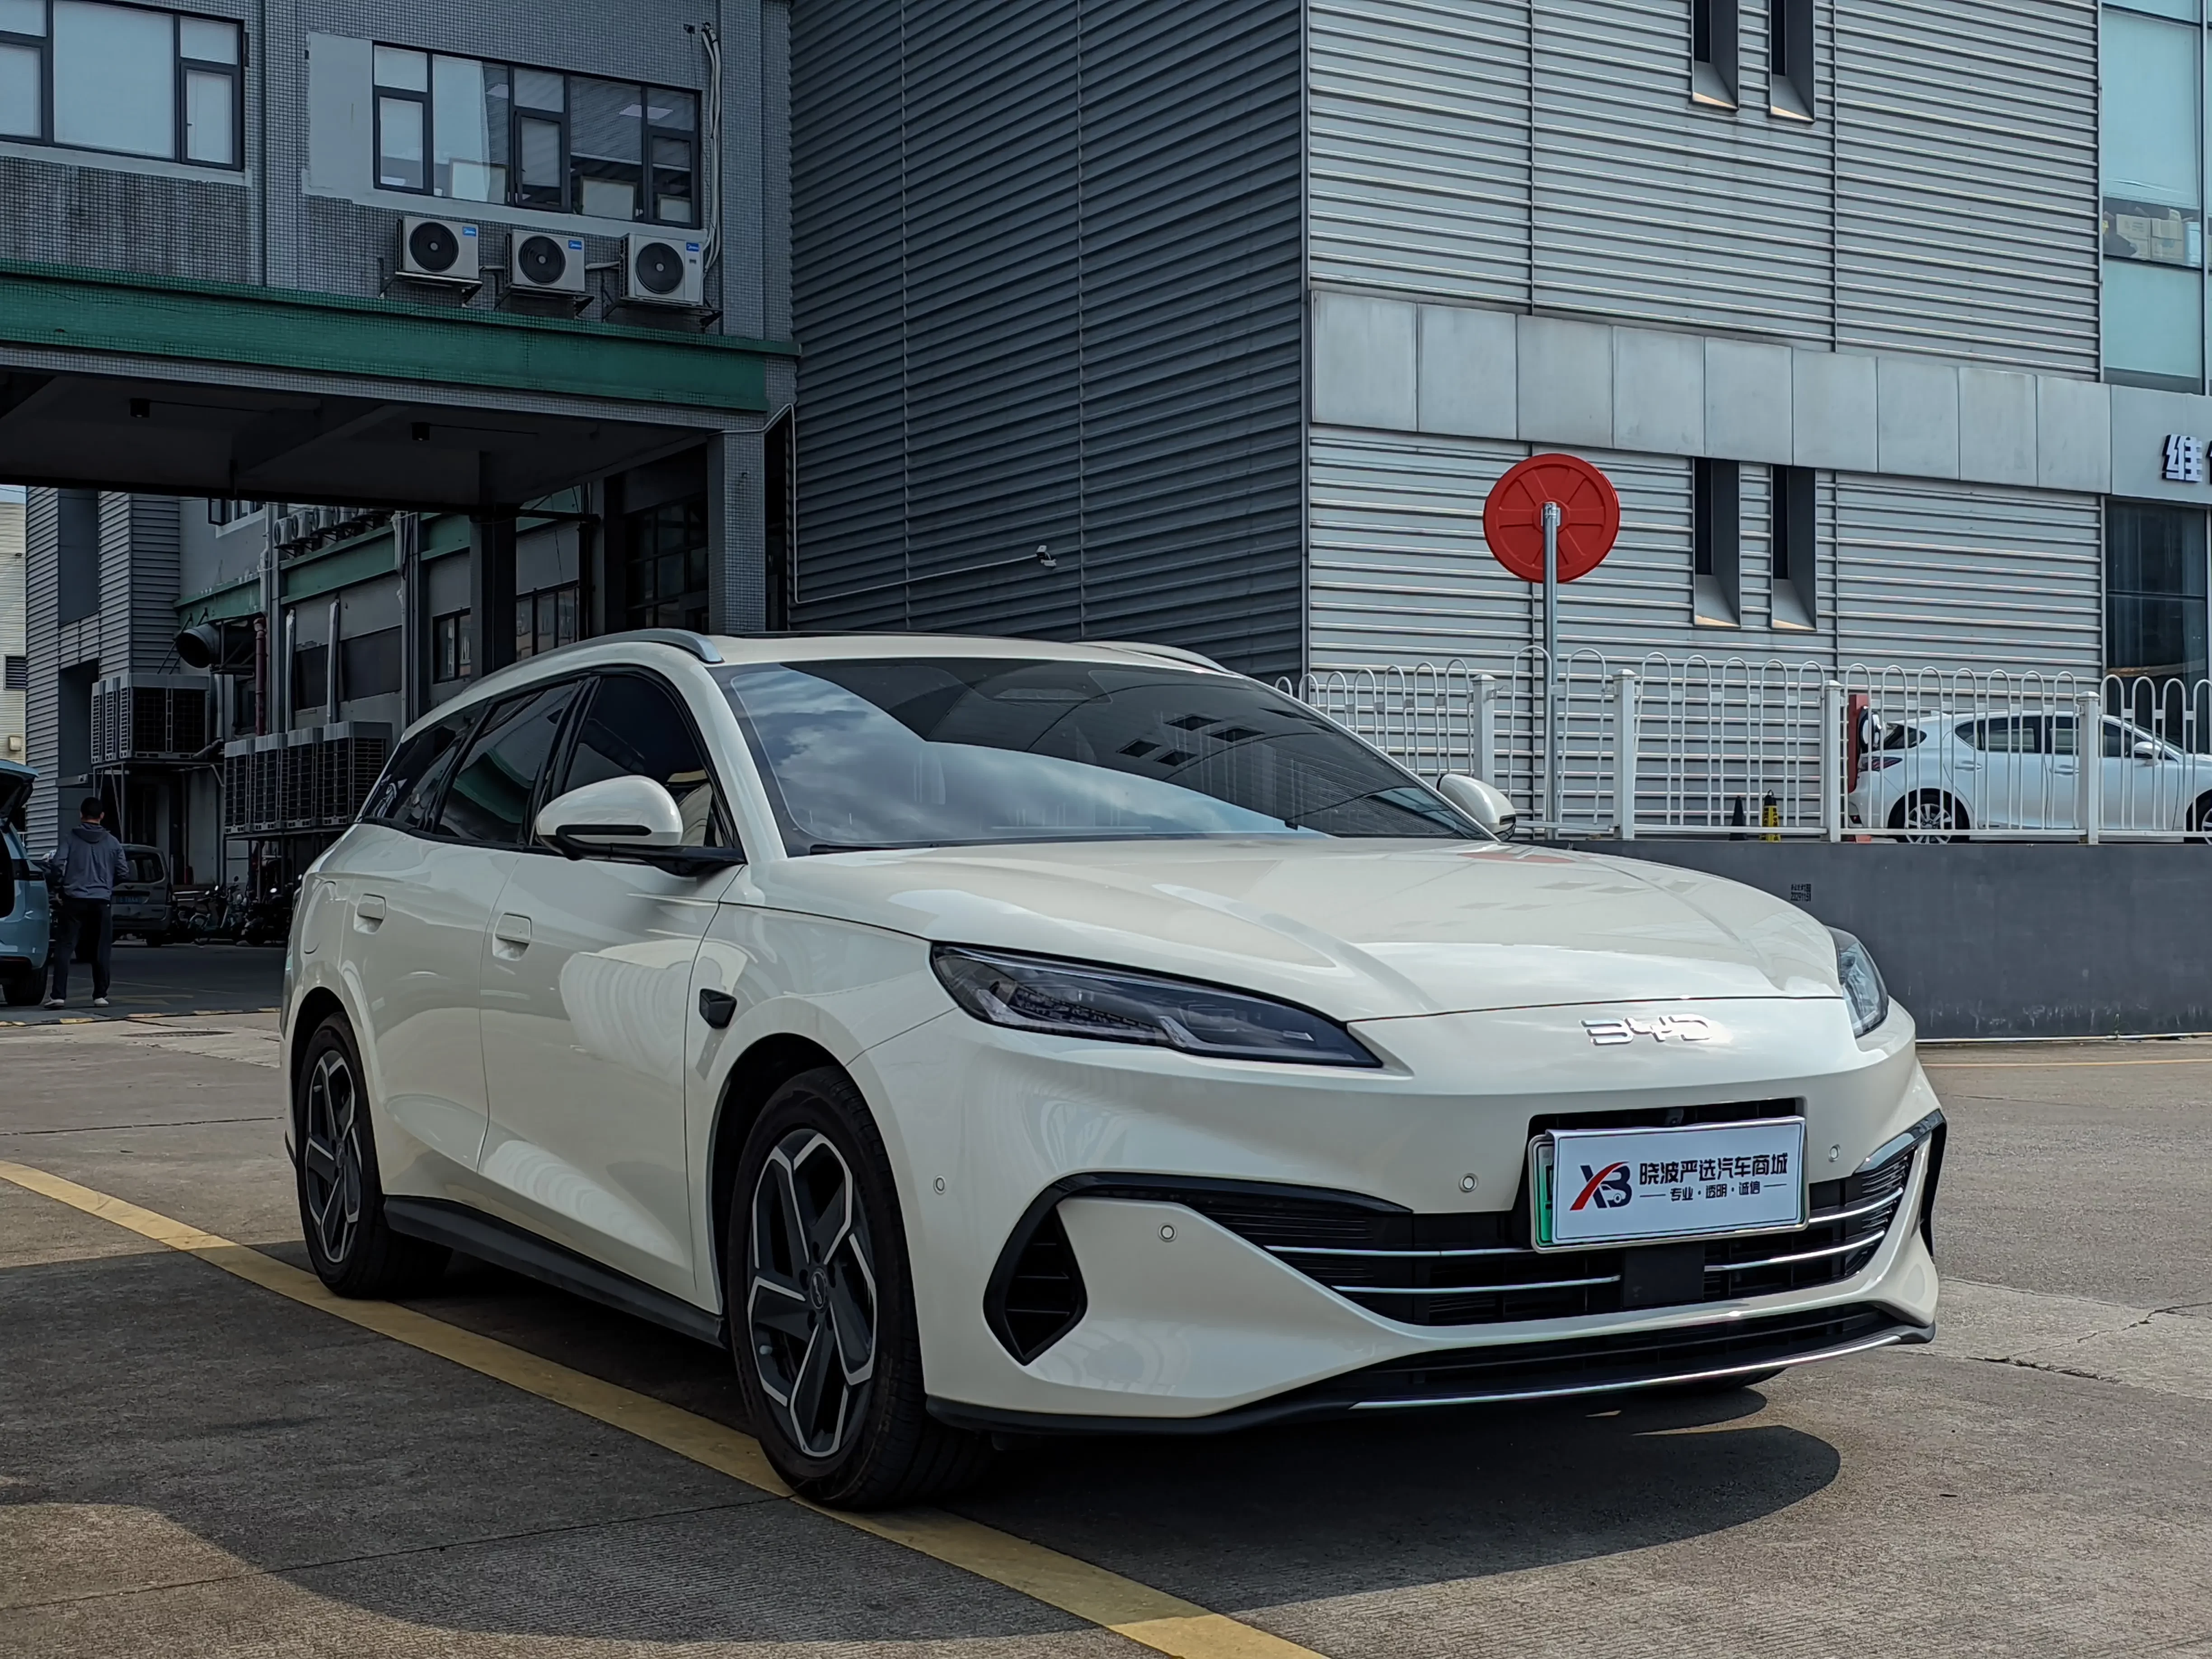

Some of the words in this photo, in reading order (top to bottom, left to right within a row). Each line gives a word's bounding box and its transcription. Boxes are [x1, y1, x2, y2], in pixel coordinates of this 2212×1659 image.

[2162, 434, 2212, 484] 维
[1579, 1015, 1713, 1046] BYD
[1640, 1153, 1788, 1185] 晓波严选汽车商城
